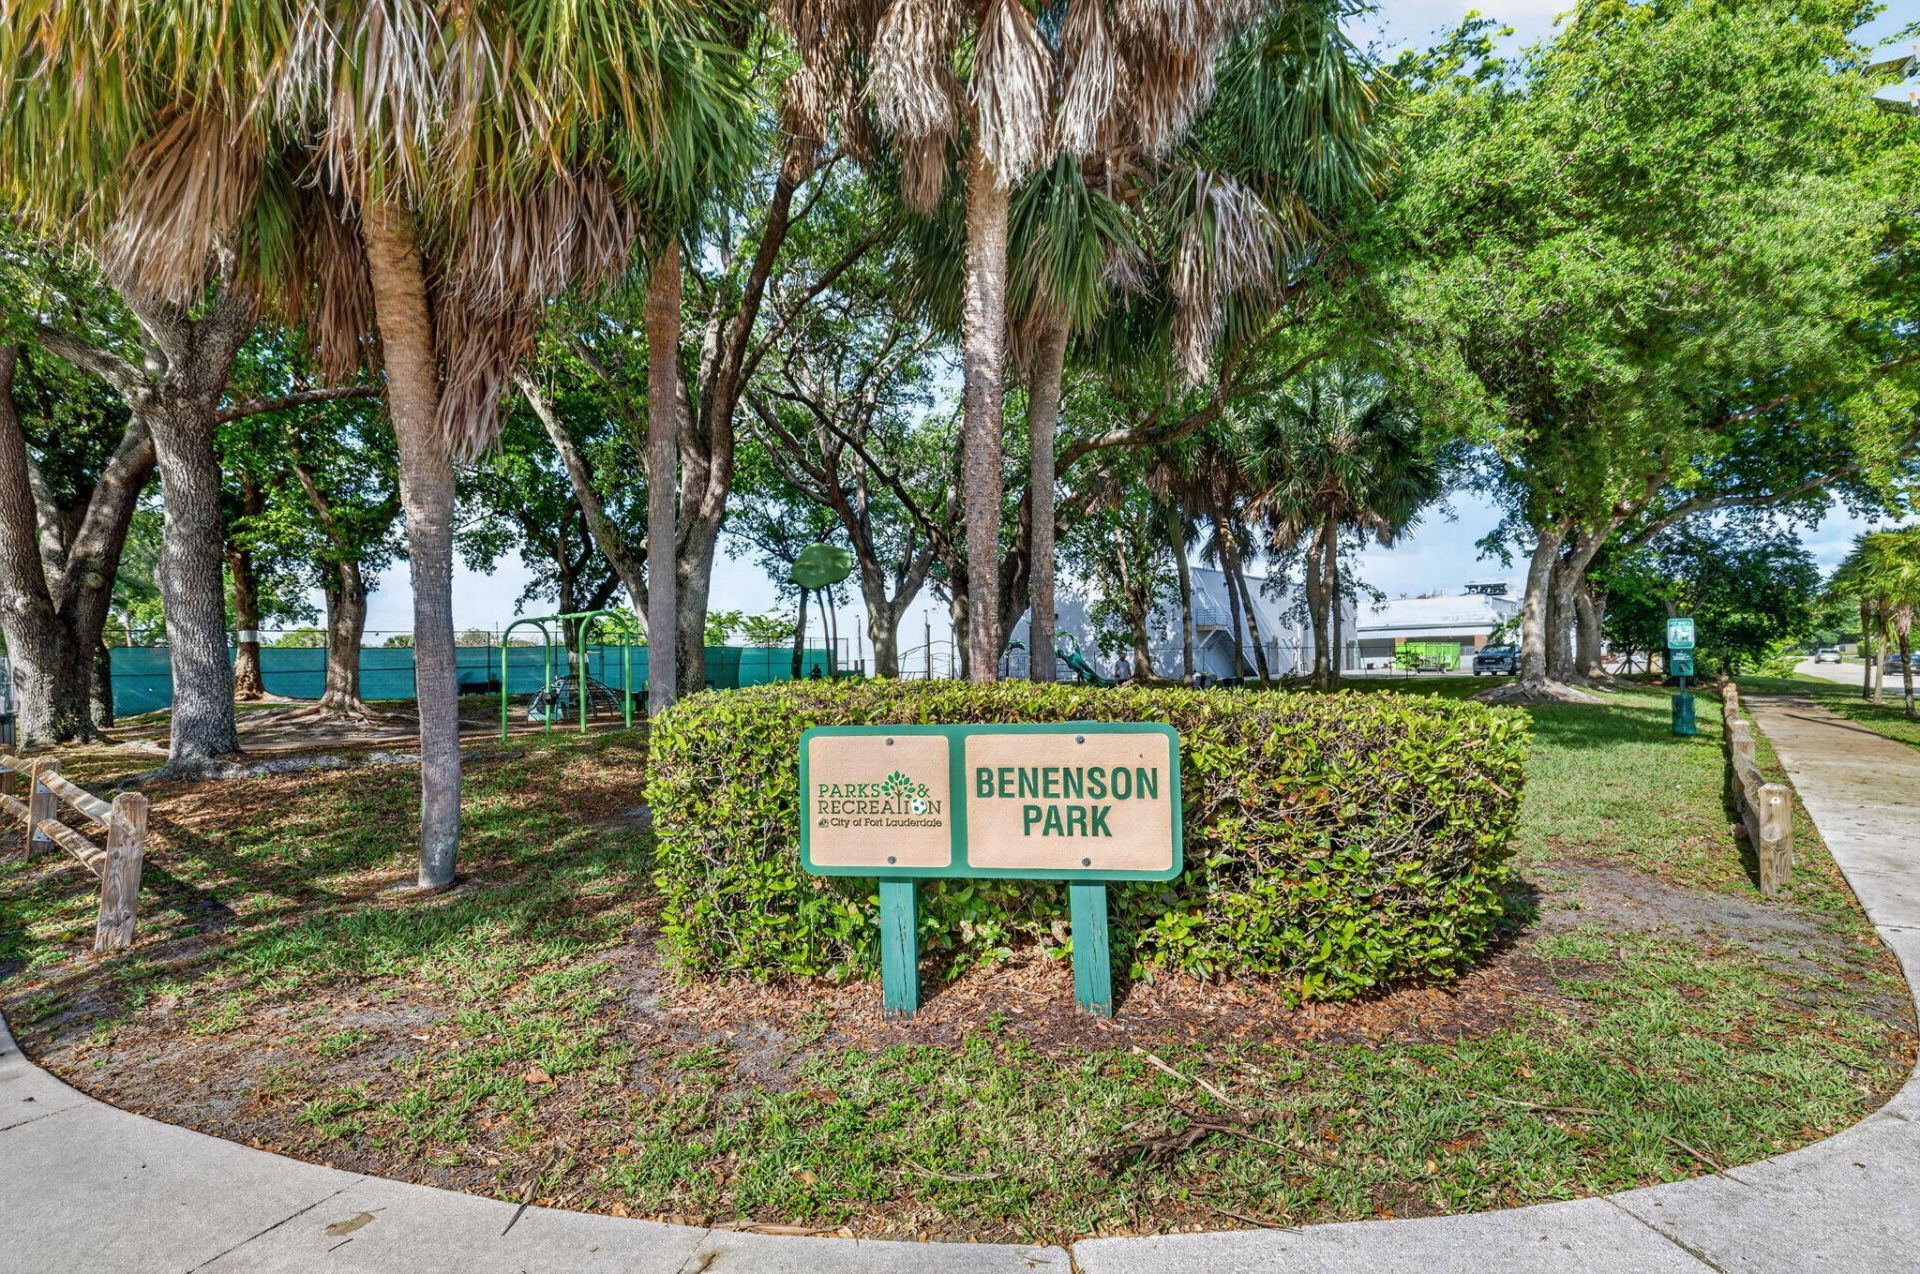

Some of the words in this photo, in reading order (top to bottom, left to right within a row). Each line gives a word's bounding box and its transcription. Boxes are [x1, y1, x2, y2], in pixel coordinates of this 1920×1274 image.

[818, 783, 880, 798] PARKS
[917, 783, 930, 798] &
[976, 766, 1158, 800] BENENSON
[830, 818, 849, 828] City
[852, 817, 862, 827] of
[864, 817, 883, 827] Fort
[885, 817, 942, 828] Lauderdale
[1023, 804, 1112, 837] PARK
